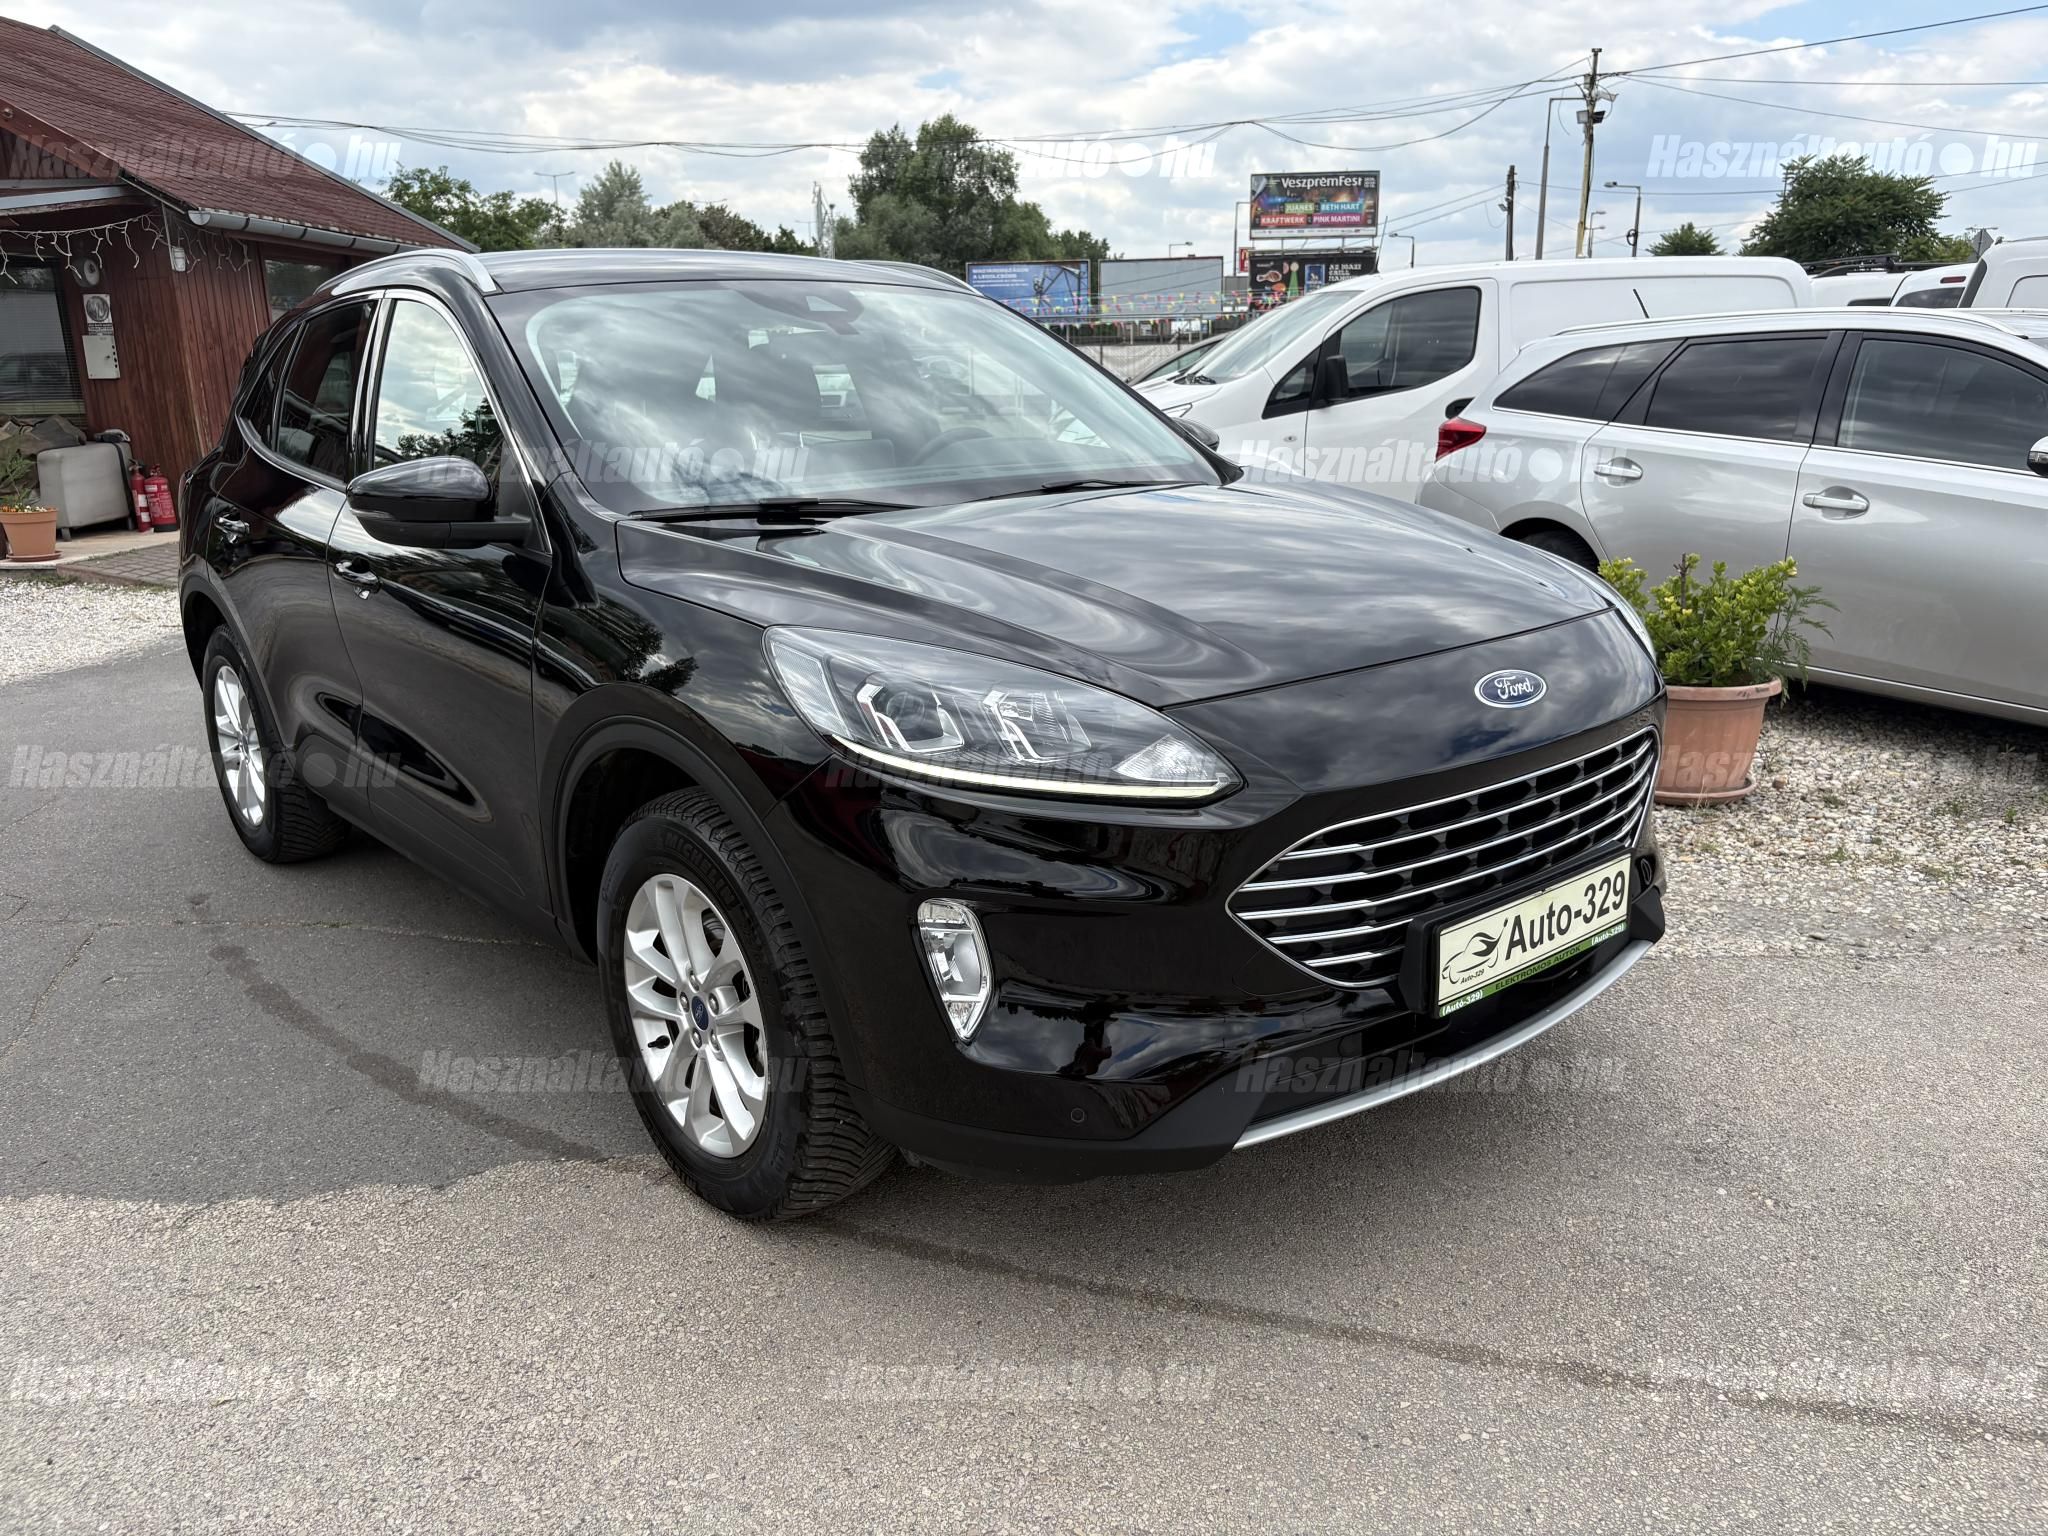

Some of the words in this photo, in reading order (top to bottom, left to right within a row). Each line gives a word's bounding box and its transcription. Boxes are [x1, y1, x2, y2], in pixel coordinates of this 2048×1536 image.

[1341, 202, 1360, 210] HART
[1262, 216, 1305, 225] KRAFTWERK
[1331, 215, 1361, 223] MARTINI
[1494, 675, 1534, 699] Ford
[1504, 870, 1626, 961] Auto-329
[1495, 959, 1552, 990] ELEKTROMOS
